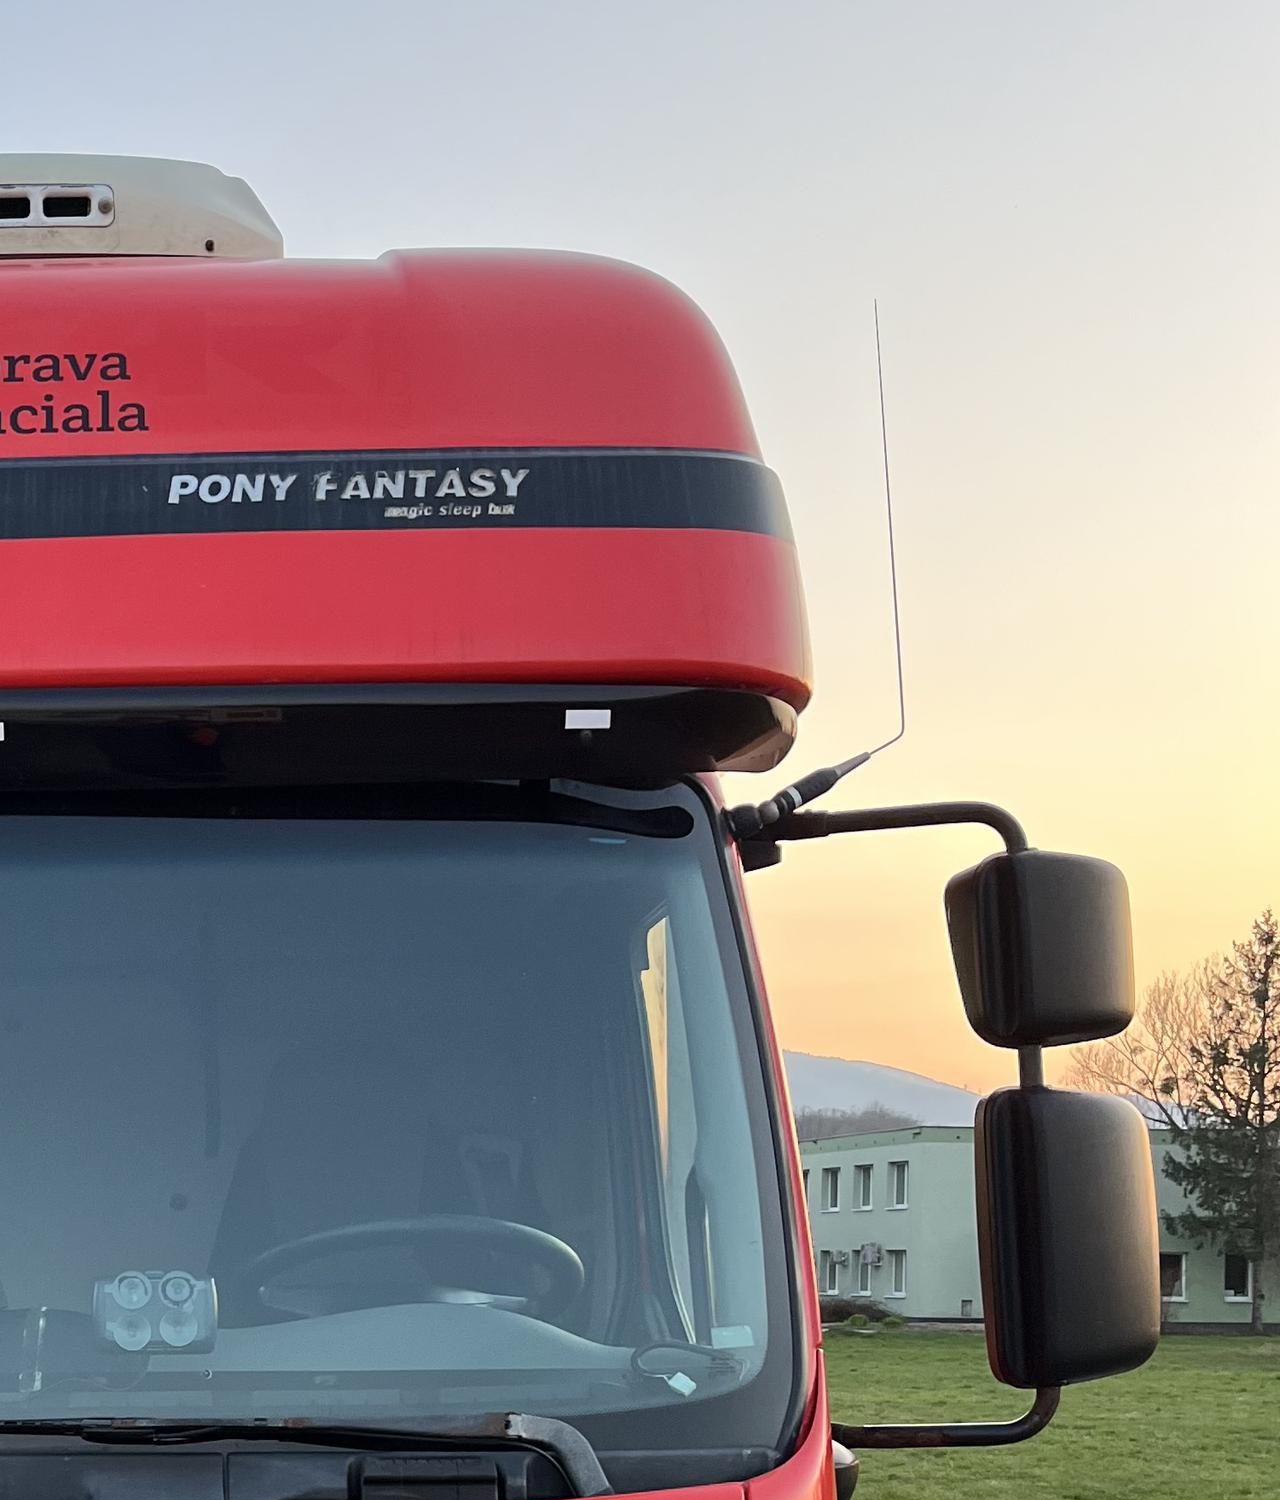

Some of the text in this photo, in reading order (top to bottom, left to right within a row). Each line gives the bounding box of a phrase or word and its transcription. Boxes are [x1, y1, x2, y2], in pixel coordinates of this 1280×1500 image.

[167, 468, 530, 504] PONY FANTASY
[438, 502, 482, 518] sleep
